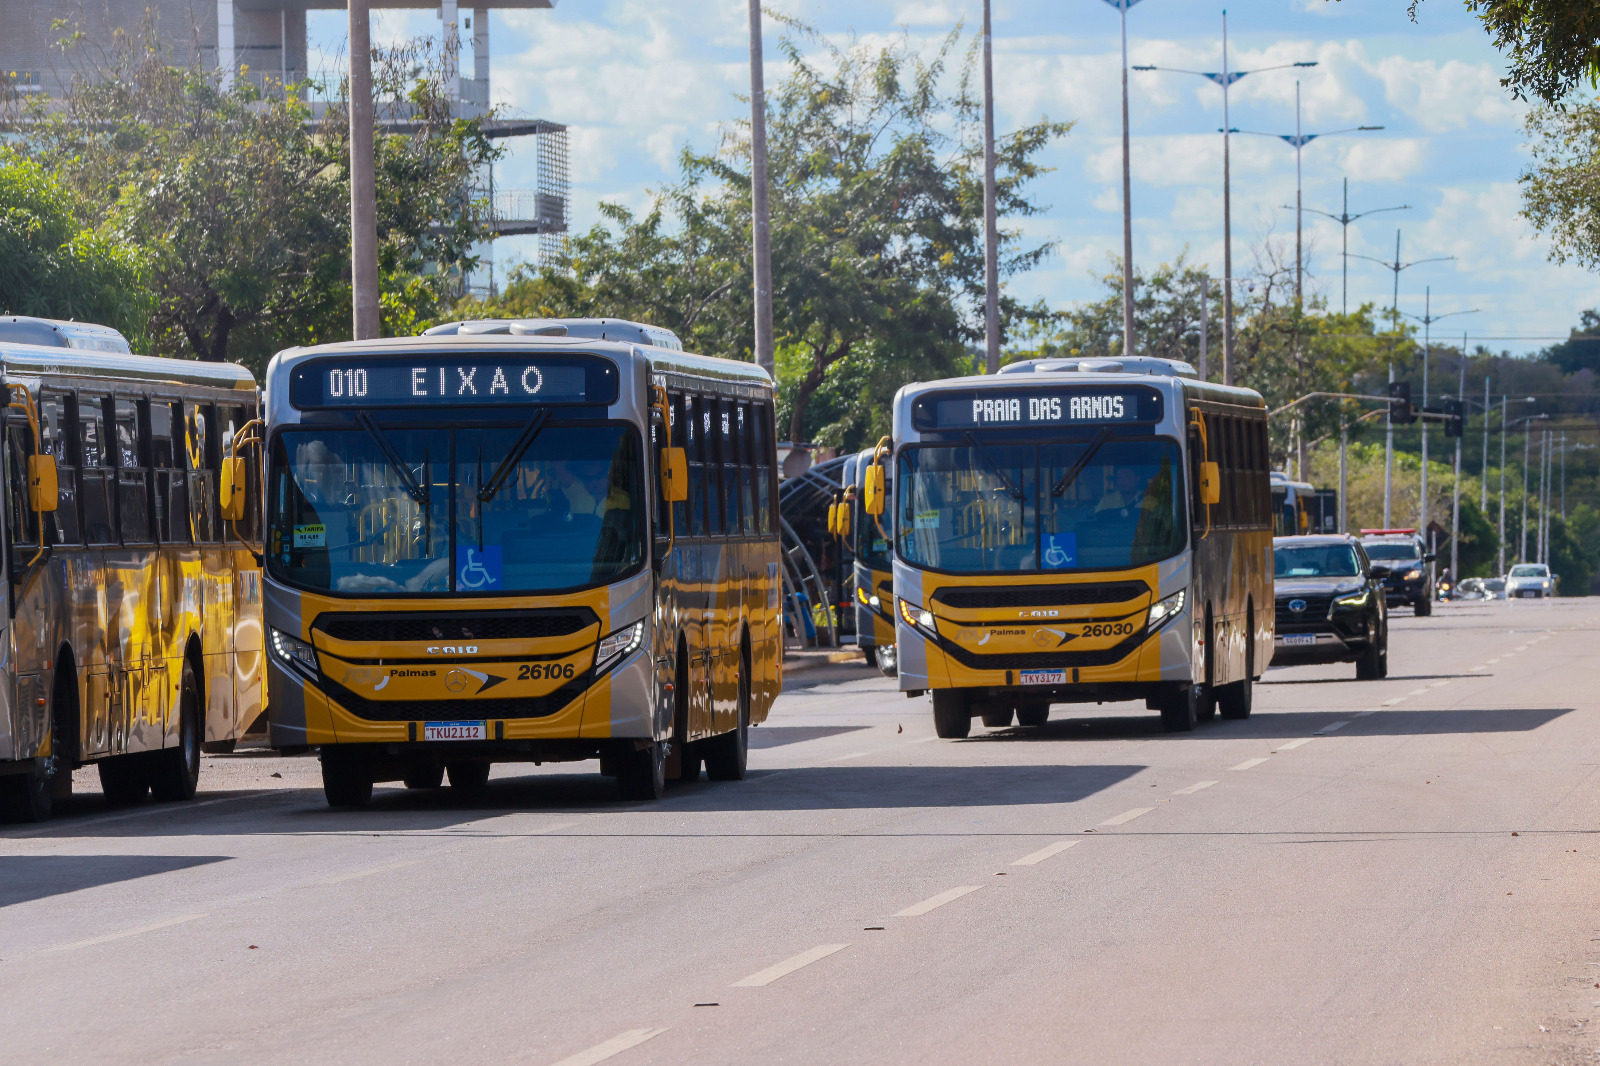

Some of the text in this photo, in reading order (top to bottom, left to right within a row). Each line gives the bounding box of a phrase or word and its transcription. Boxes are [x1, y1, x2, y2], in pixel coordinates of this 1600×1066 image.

[330, 366, 543, 397] 010 EIXAO
[972, 395, 1124, 422] PRAIA DAS ARNOS
[1081, 622, 1134, 638] 26030
[390, 669, 437, 677] Palmas
[517, 663, 575, 681] 26106
